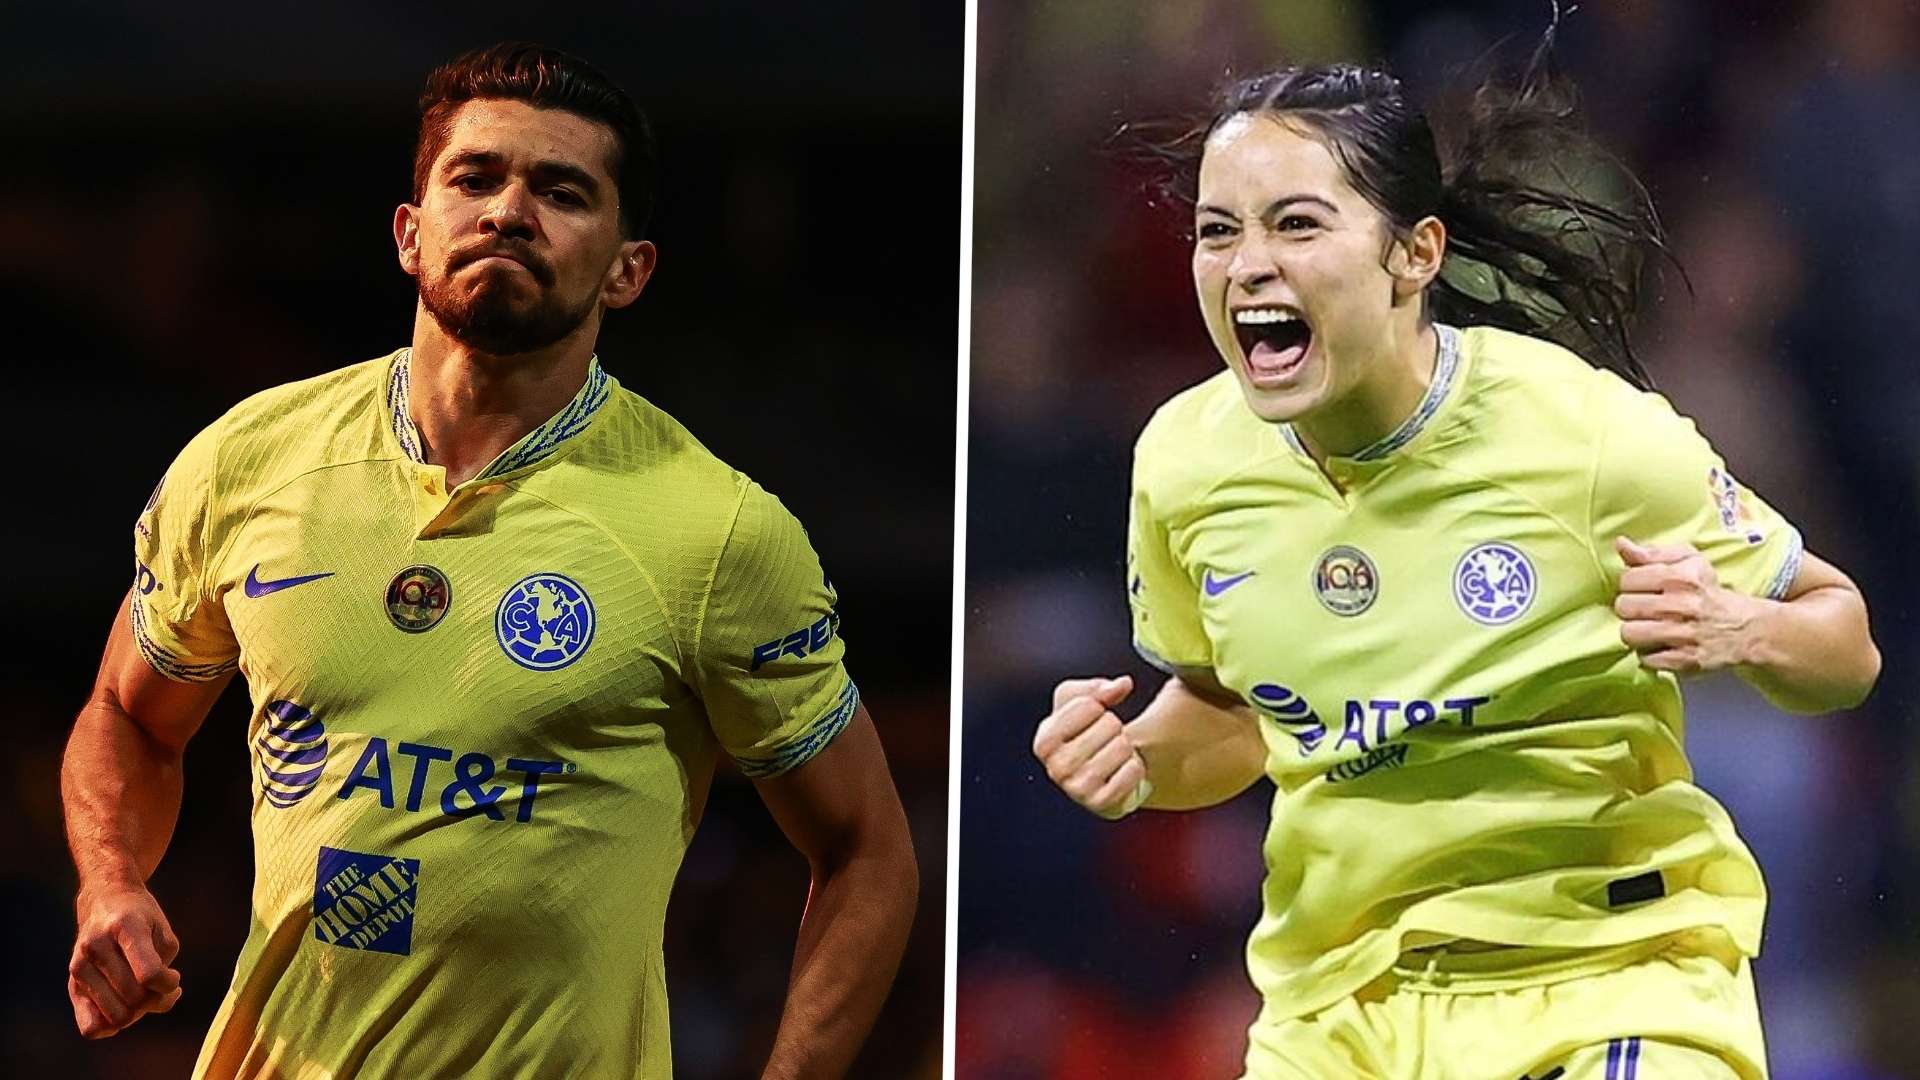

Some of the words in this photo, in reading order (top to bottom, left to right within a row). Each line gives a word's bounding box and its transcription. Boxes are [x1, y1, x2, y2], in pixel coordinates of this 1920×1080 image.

[750, 613, 840, 672] FRE
[337, 737, 564, 823] AT&T
[314, 859, 418, 945] HOME
[323, 863, 366, 900] THE
